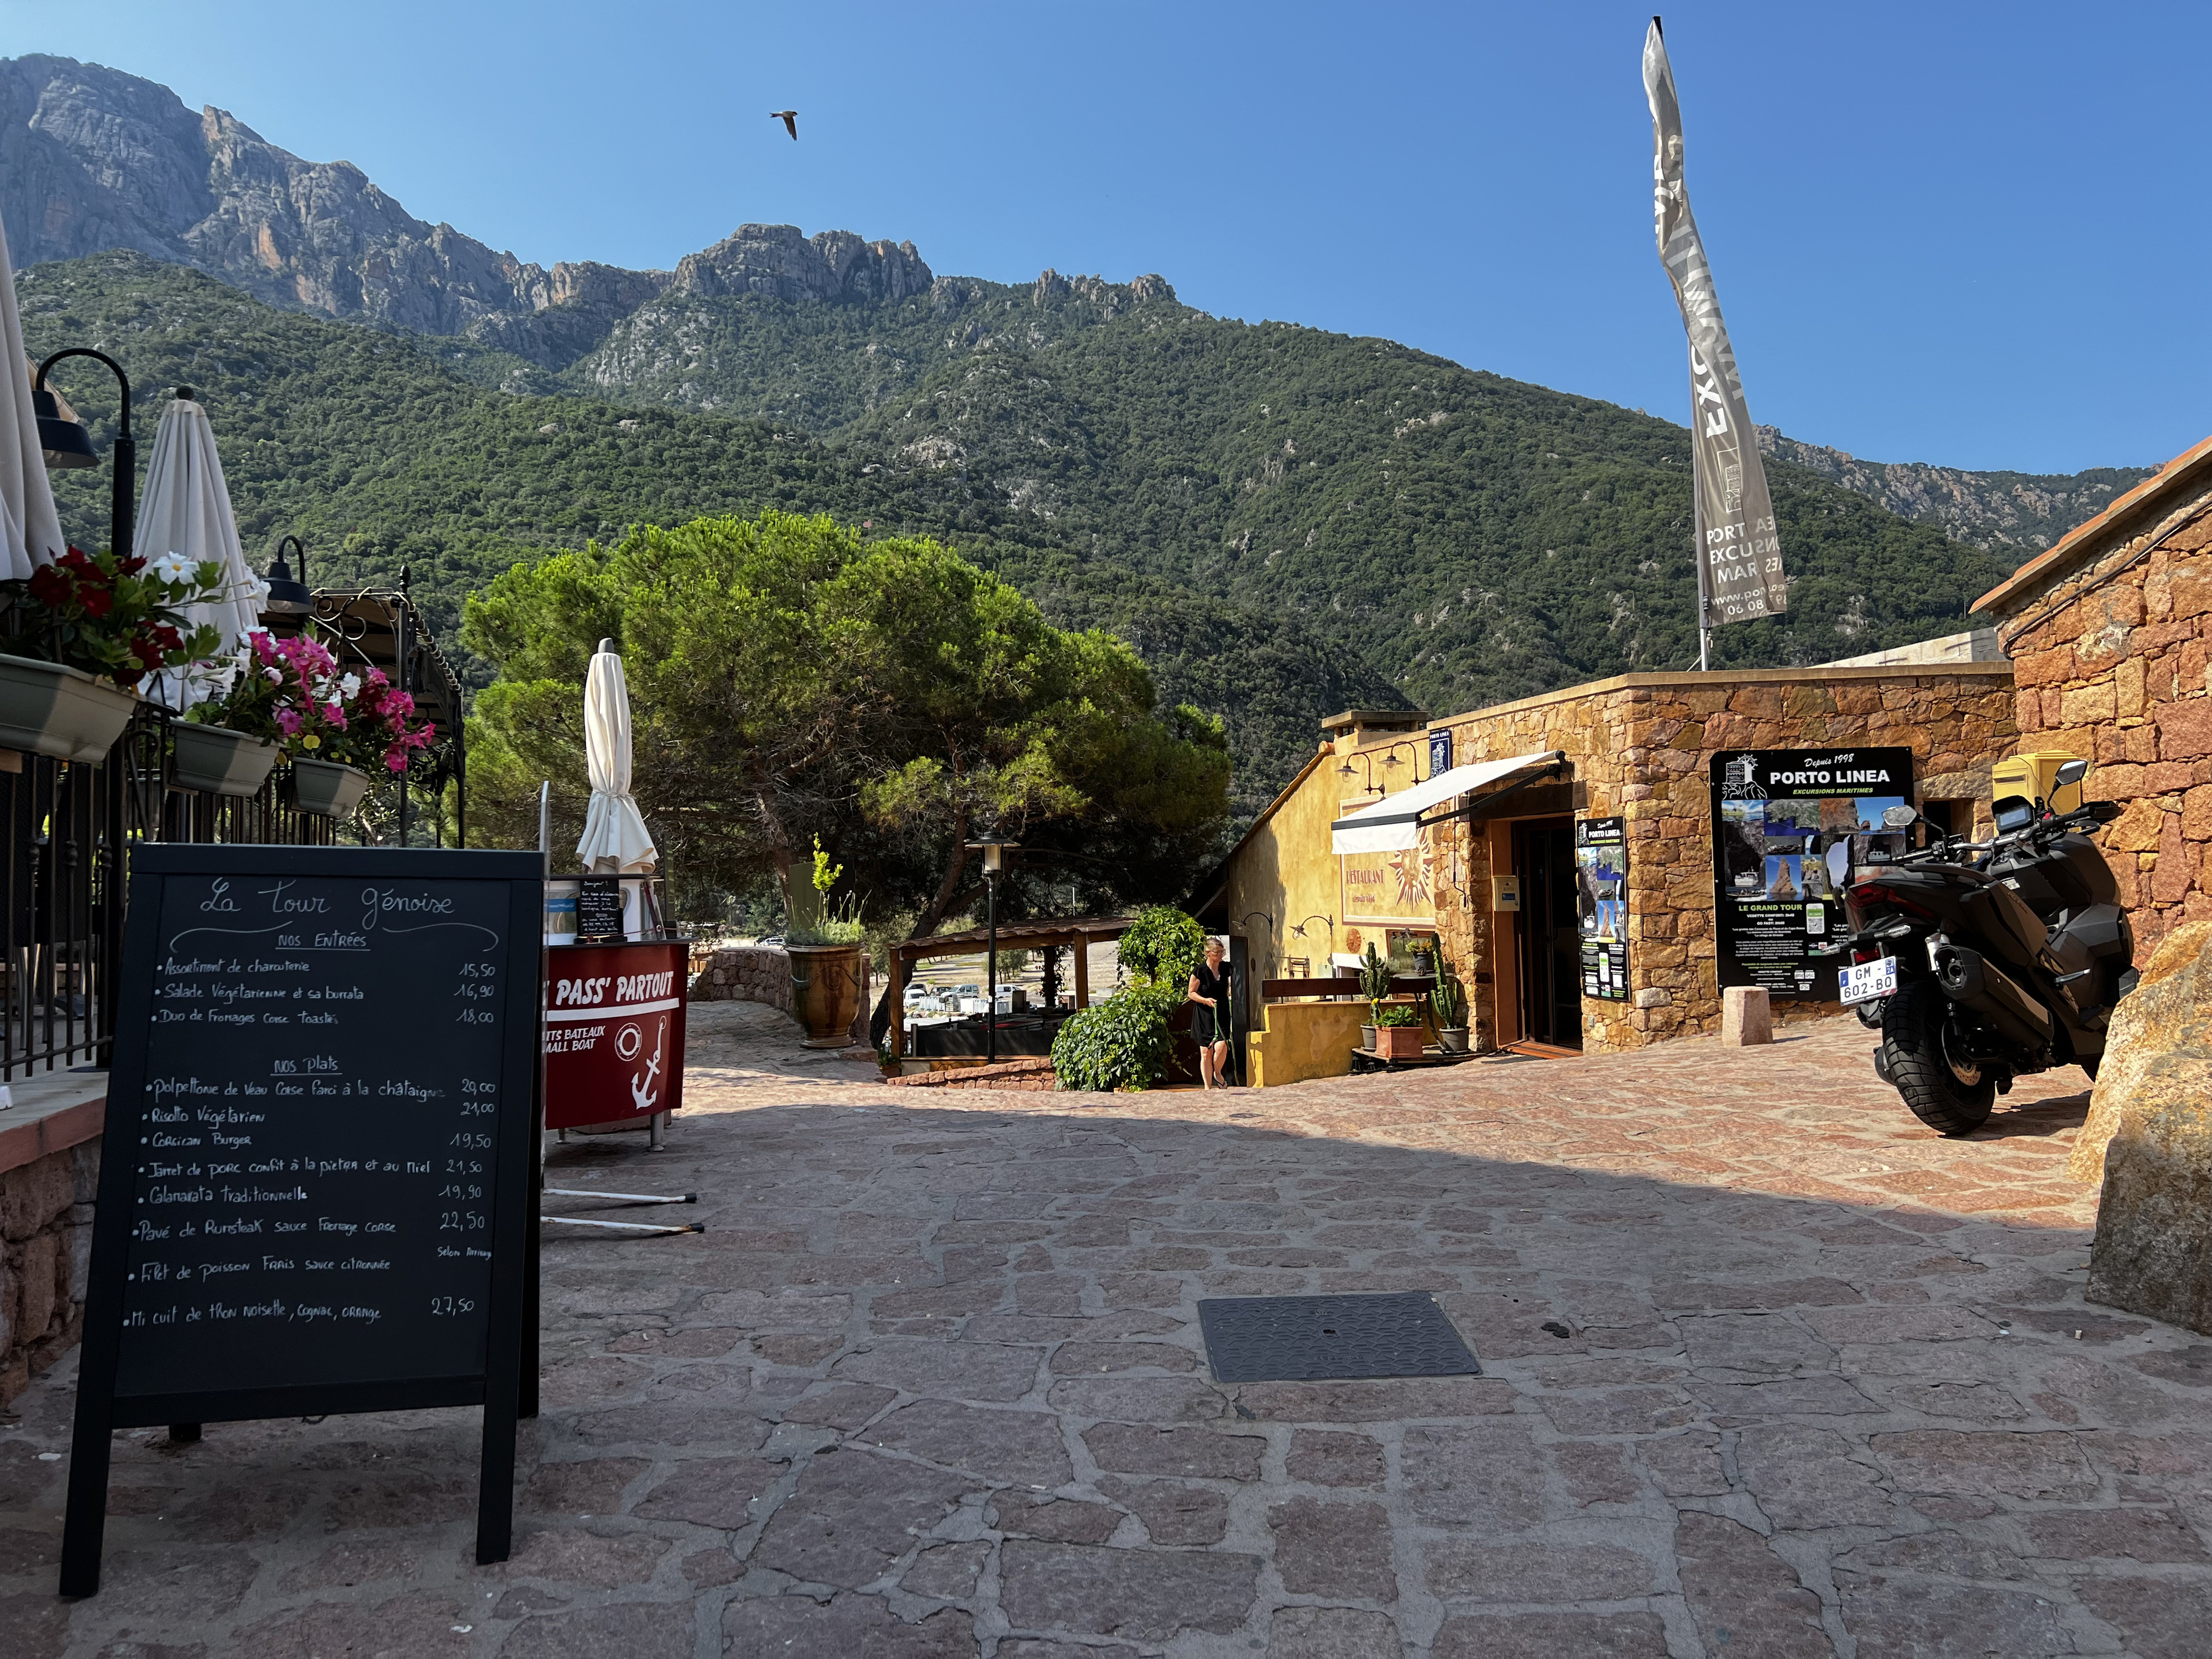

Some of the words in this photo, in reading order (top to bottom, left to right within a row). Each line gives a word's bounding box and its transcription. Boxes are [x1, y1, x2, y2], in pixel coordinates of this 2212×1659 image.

[1747, 599, 1764, 611] 08
[1804, 758, 1832, 768] Depuis
[1834, 753, 1854, 764] 1998
[1770, 771, 1830, 785] PORTO
[1836, 769, 1890, 783] LINEA
[1346, 869, 1384, 884] RESTAURANT
[200, 877, 242, 911] La
[227, 959, 241, 973] de
[459, 963, 495, 978] 15,50
[1856, 966, 1871, 980] GM
[164, 983, 204, 998] Salade
[293, 987, 304, 999] et
[326, 985, 364, 999] burrata
[453, 984, 494, 1000] 16,90
[555, 977, 611, 1005] PASS'
[615, 971, 674, 1002] PARTOUT
[190, 1008, 204, 1021] de
[456, 1008, 494, 1025] 18,00
[564, 1025, 606, 1039] BATEAUX
[571, 1039, 596, 1051] BOAT
[224, 1081, 238, 1095] de
[358, 1079, 369, 1095] la
[461, 1078, 496, 1096] 20,00
[460, 1102, 495, 1117] 21,00
[450, 1133, 492, 1150] 19,50
[186, 1162, 201, 1176] de
[305, 1156, 316, 1170] la
[365, 1159, 379, 1171] et
[446, 1159, 482, 1175] 21,50
[438, 1184, 482, 1201] 19,90
[440, 1211, 485, 1232] 22,50
[139, 1219, 171, 1241] Pavé
[179, 1220, 196, 1237] de
[176, 1265, 191, 1280] de
[186, 1307, 202, 1322] de
[432, 1297, 474, 1317] 27,50
